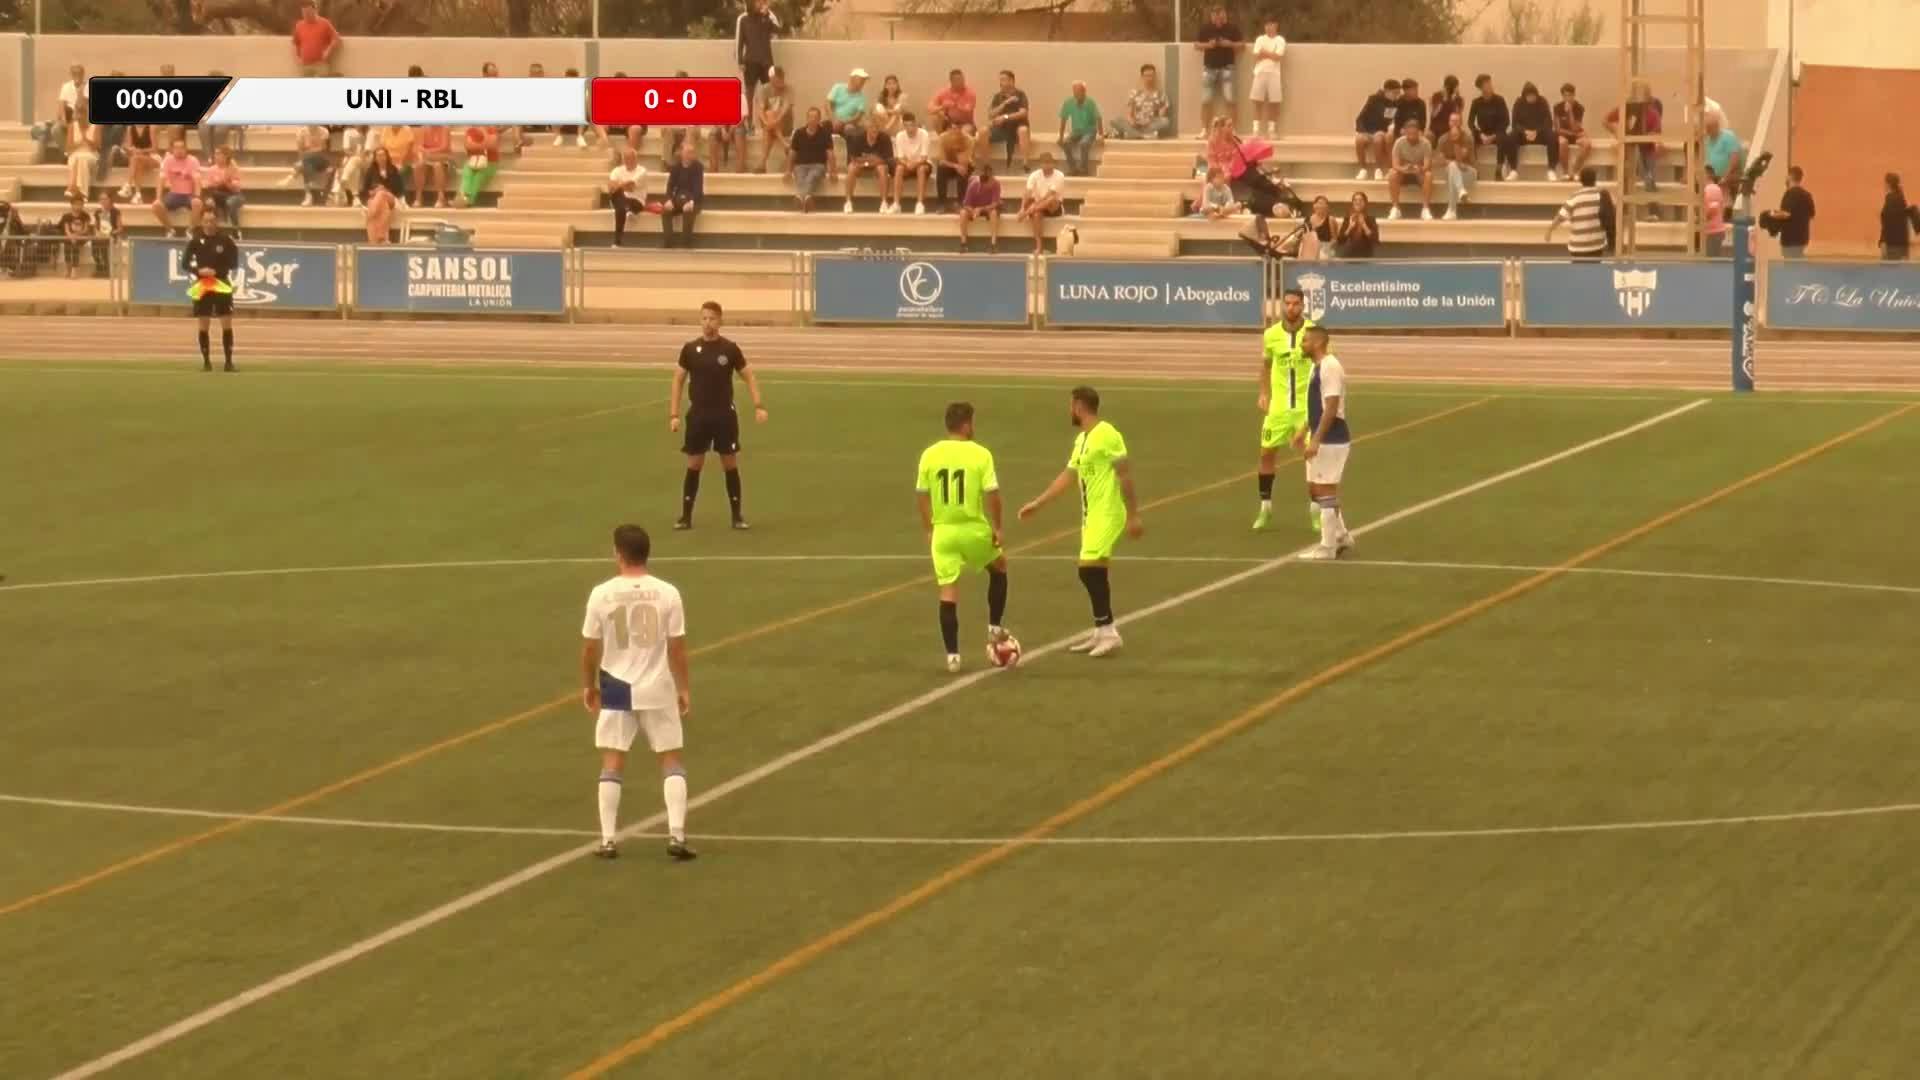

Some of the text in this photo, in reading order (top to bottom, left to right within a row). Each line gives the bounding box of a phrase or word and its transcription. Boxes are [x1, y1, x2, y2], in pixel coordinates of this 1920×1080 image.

[408, 256, 512, 281] SANSOL
[1059, 284, 1250, 306] LUNA ROJO Abogados
[1330, 295, 1496, 310] Ayuntamiento de la Unión
[935, 468, 966, 505] 11
[607, 603, 659, 651] 19
